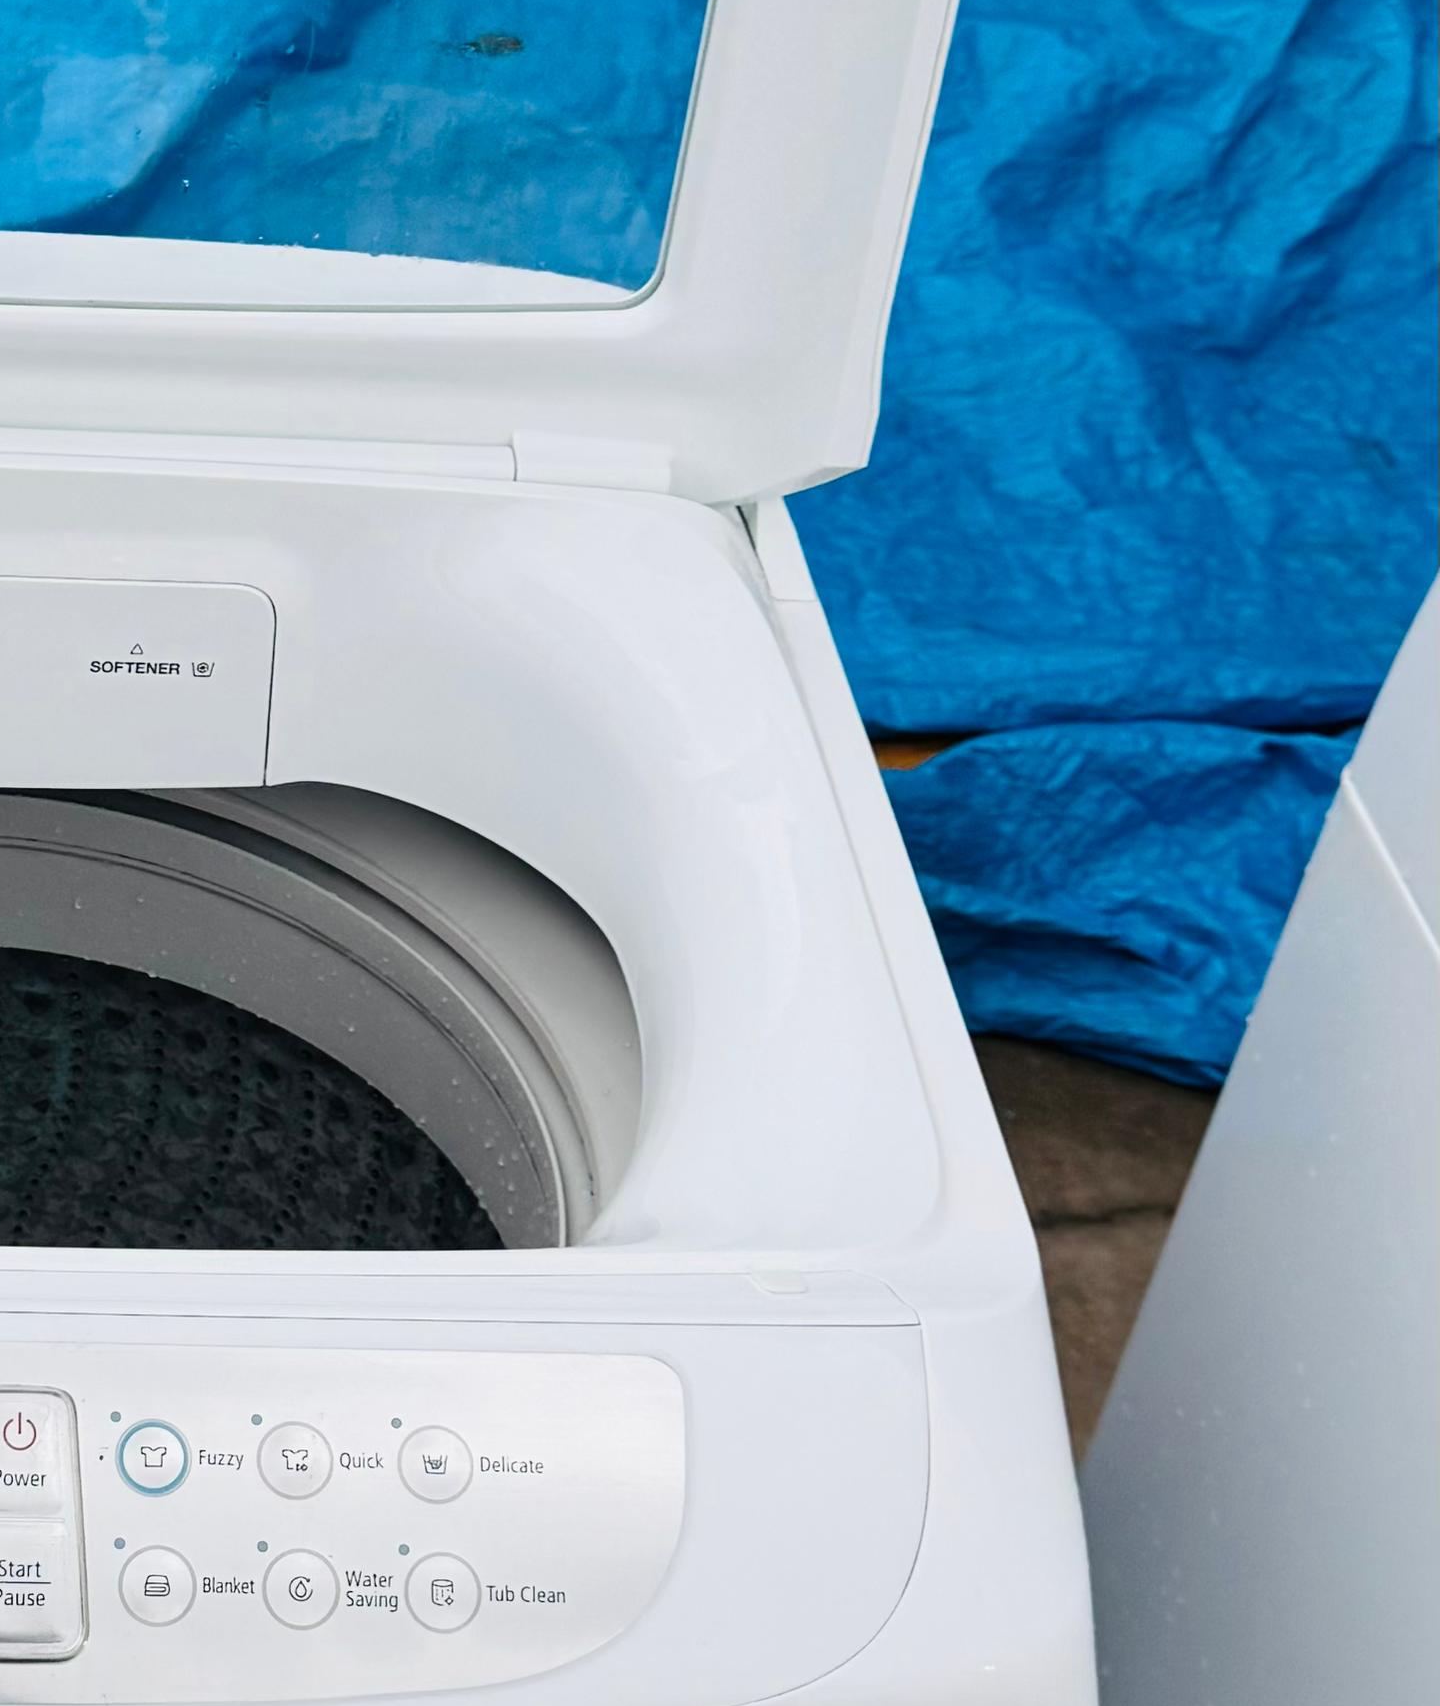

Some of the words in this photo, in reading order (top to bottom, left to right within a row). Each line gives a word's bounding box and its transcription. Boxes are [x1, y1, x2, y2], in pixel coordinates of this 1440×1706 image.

[89, 660, 181, 675] SOFTENER
[198, 1449, 244, 1471] Fuzzy
[339, 1452, 384, 1471] Quick
[479, 1455, 544, 1474] Delicate
[202, 1576, 255, 1595] Blanket
[345, 1570, 394, 1589] Water
[345, 1590, 399, 1613] Saving
[485, 1584, 515, 1602] Tub
[520, 1585, 566, 1604] Clean
